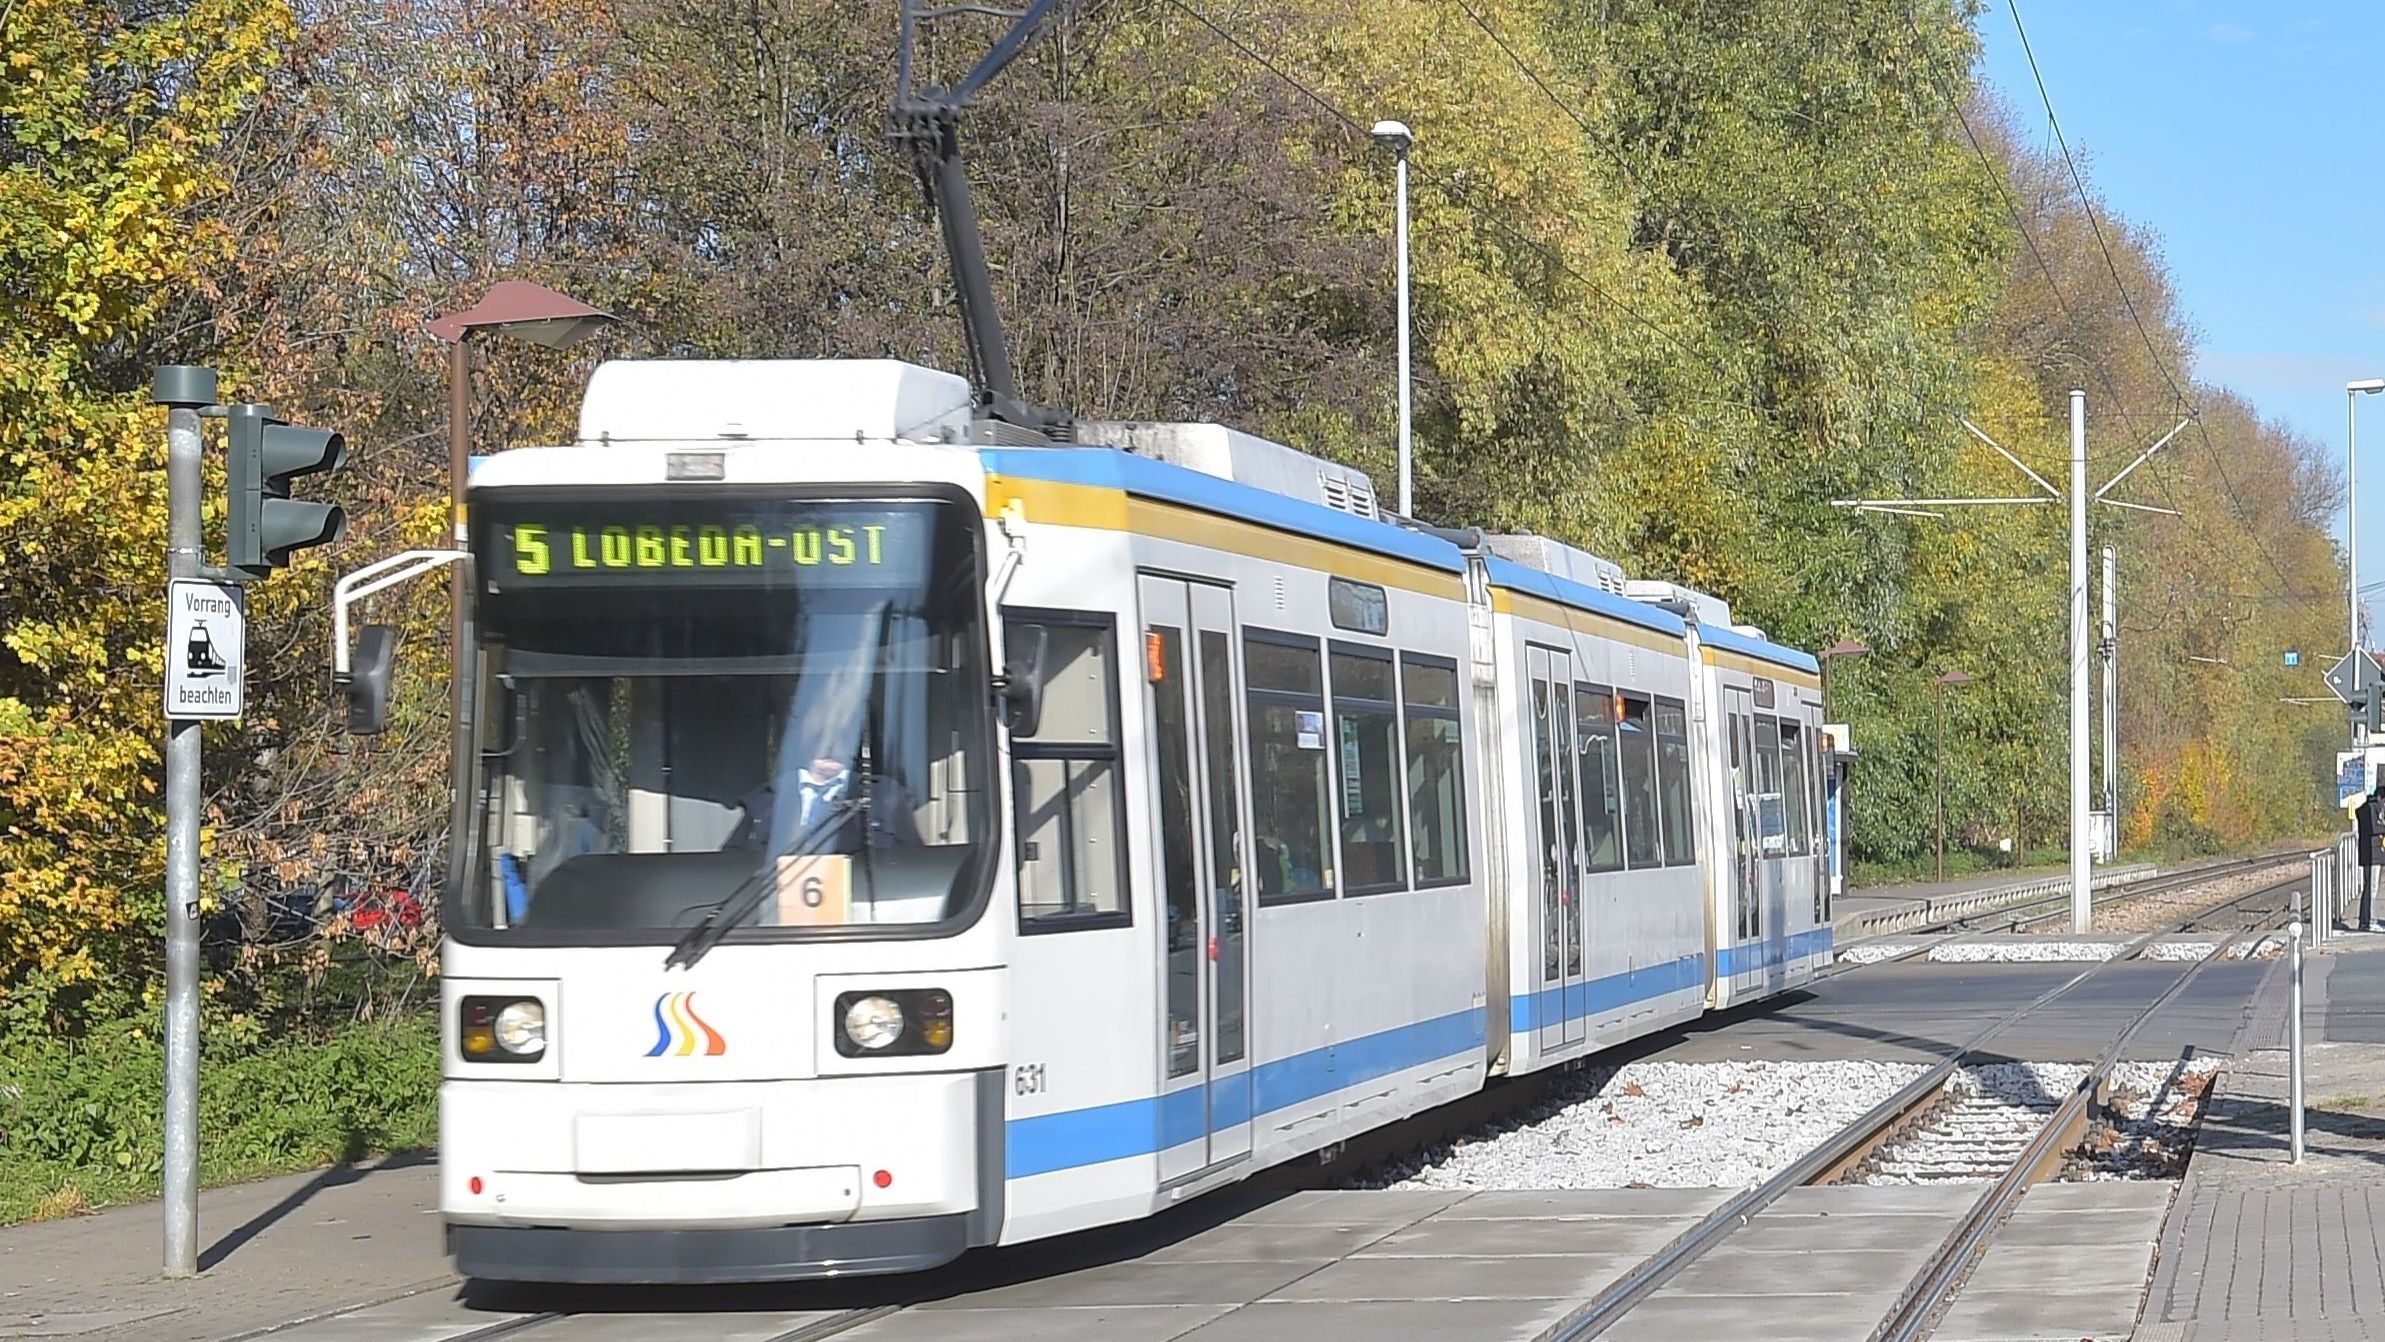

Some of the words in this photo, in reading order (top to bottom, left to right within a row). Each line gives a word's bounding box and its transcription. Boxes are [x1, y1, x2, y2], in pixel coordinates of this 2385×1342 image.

[514, 523, 551, 575] 5
[186, 592, 231, 618] Vorrang
[179, 685, 232, 705] beachten
[803, 876, 823, 908] 6
[1015, 1063, 1047, 1097] 631
